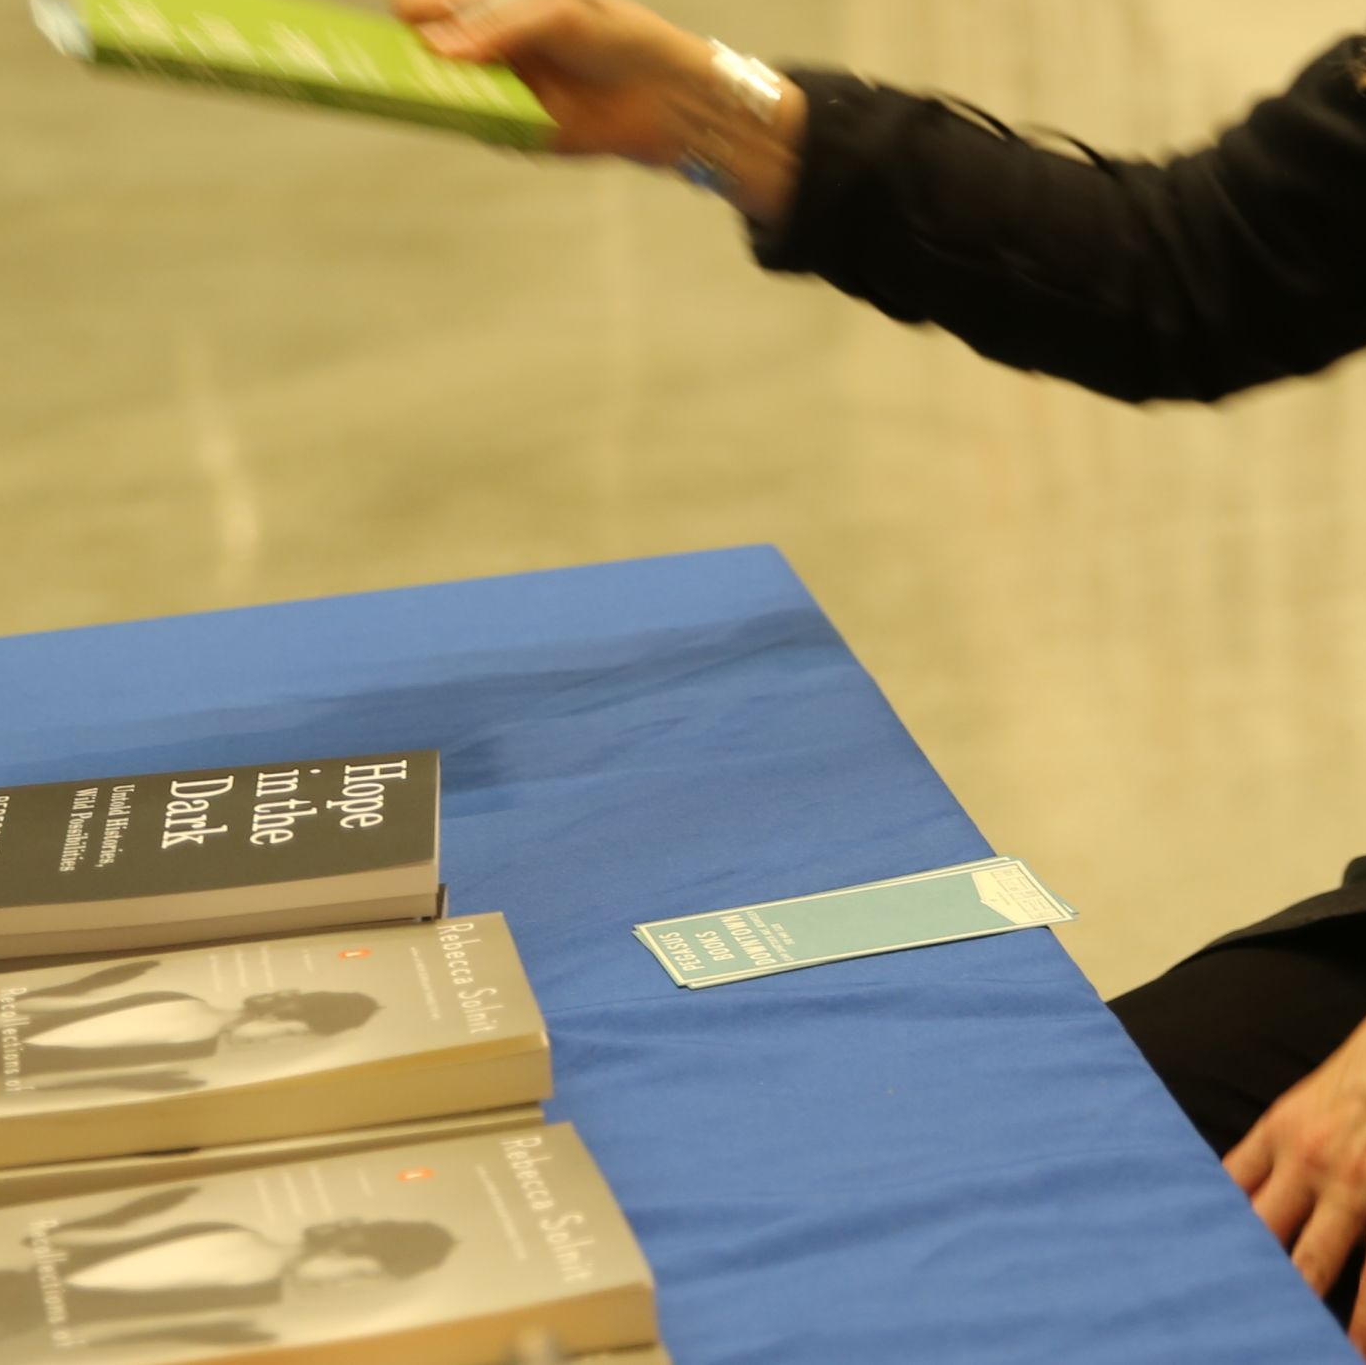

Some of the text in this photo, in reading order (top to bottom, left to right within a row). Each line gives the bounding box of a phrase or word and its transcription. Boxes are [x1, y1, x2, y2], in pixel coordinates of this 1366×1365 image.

[59, 787, 98, 872] Wild Possibilities
[94, 784, 135, 867] Untold Histories,
[162, 775, 234, 850] Dark
[249, 767, 322, 845] in the
[326, 760, 407, 828] Hope
[436, 922, 505, 1034] Rebecca Solnit
[658, 930, 706, 971] PEGASUS
[695, 930, 735, 962] BOOKS
[719, 914, 778, 967] DOWNTOWN
[0, 986, 31, 1075] Recollections
[498, 1136, 555, 1211] Rebecca
[538, 1213, 596, 1282] Solnit
